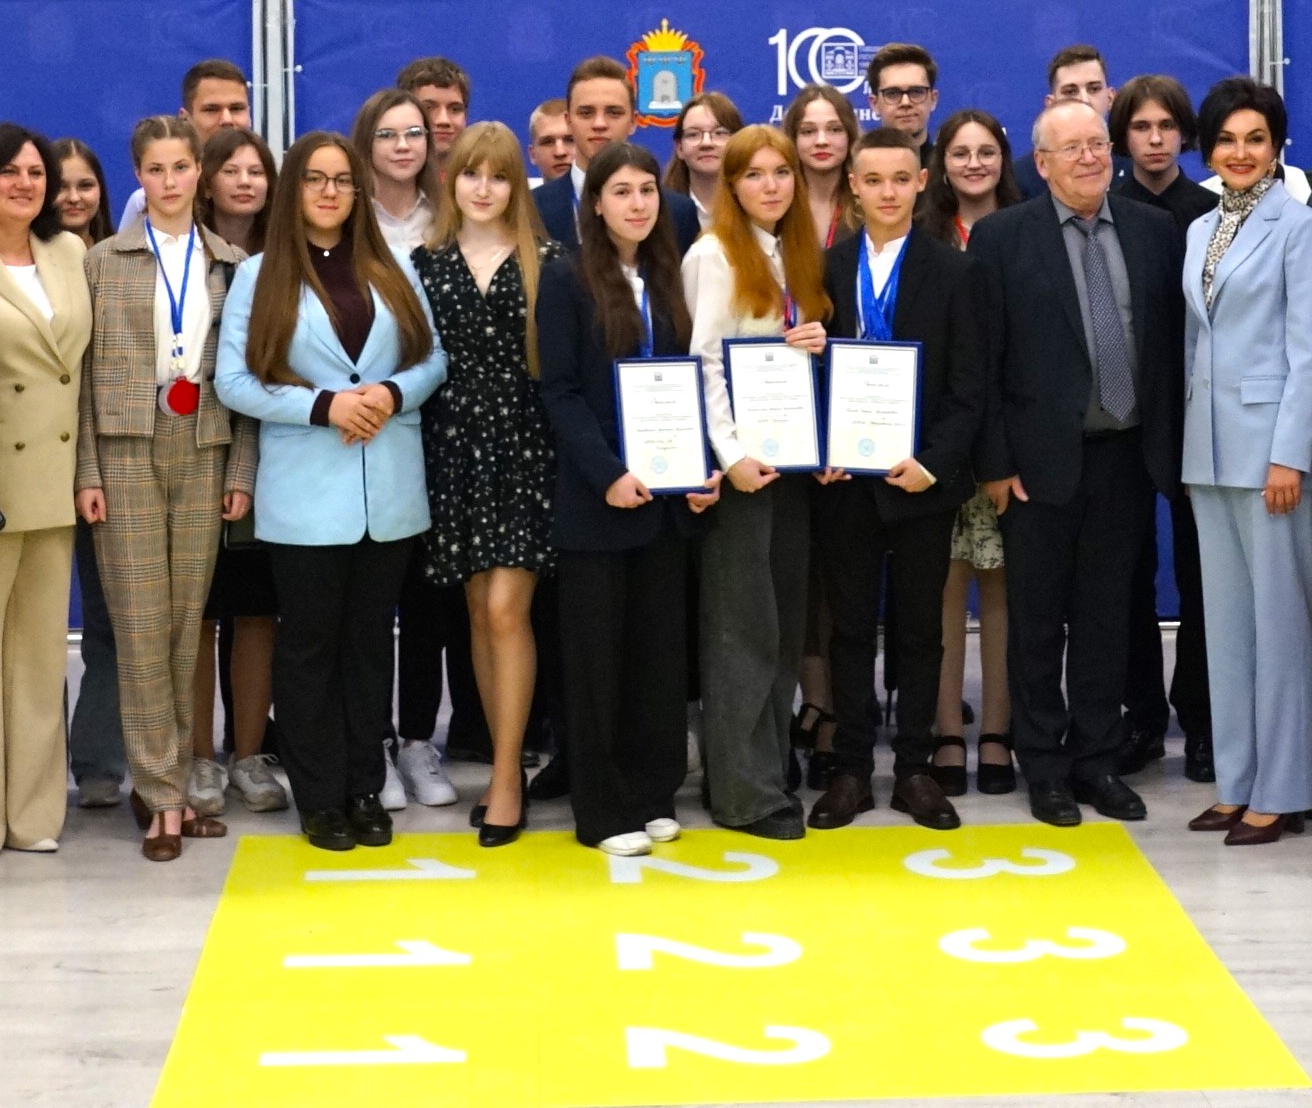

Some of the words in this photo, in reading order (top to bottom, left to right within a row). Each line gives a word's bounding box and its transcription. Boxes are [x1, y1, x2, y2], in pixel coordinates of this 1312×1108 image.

[903, 848, 1076, 880] 3
[614, 931, 804, 971] 2
[938, 926, 1128, 964] 3
[624, 1024, 833, 1069] 2
[980, 1017, 1190, 1059] 3
